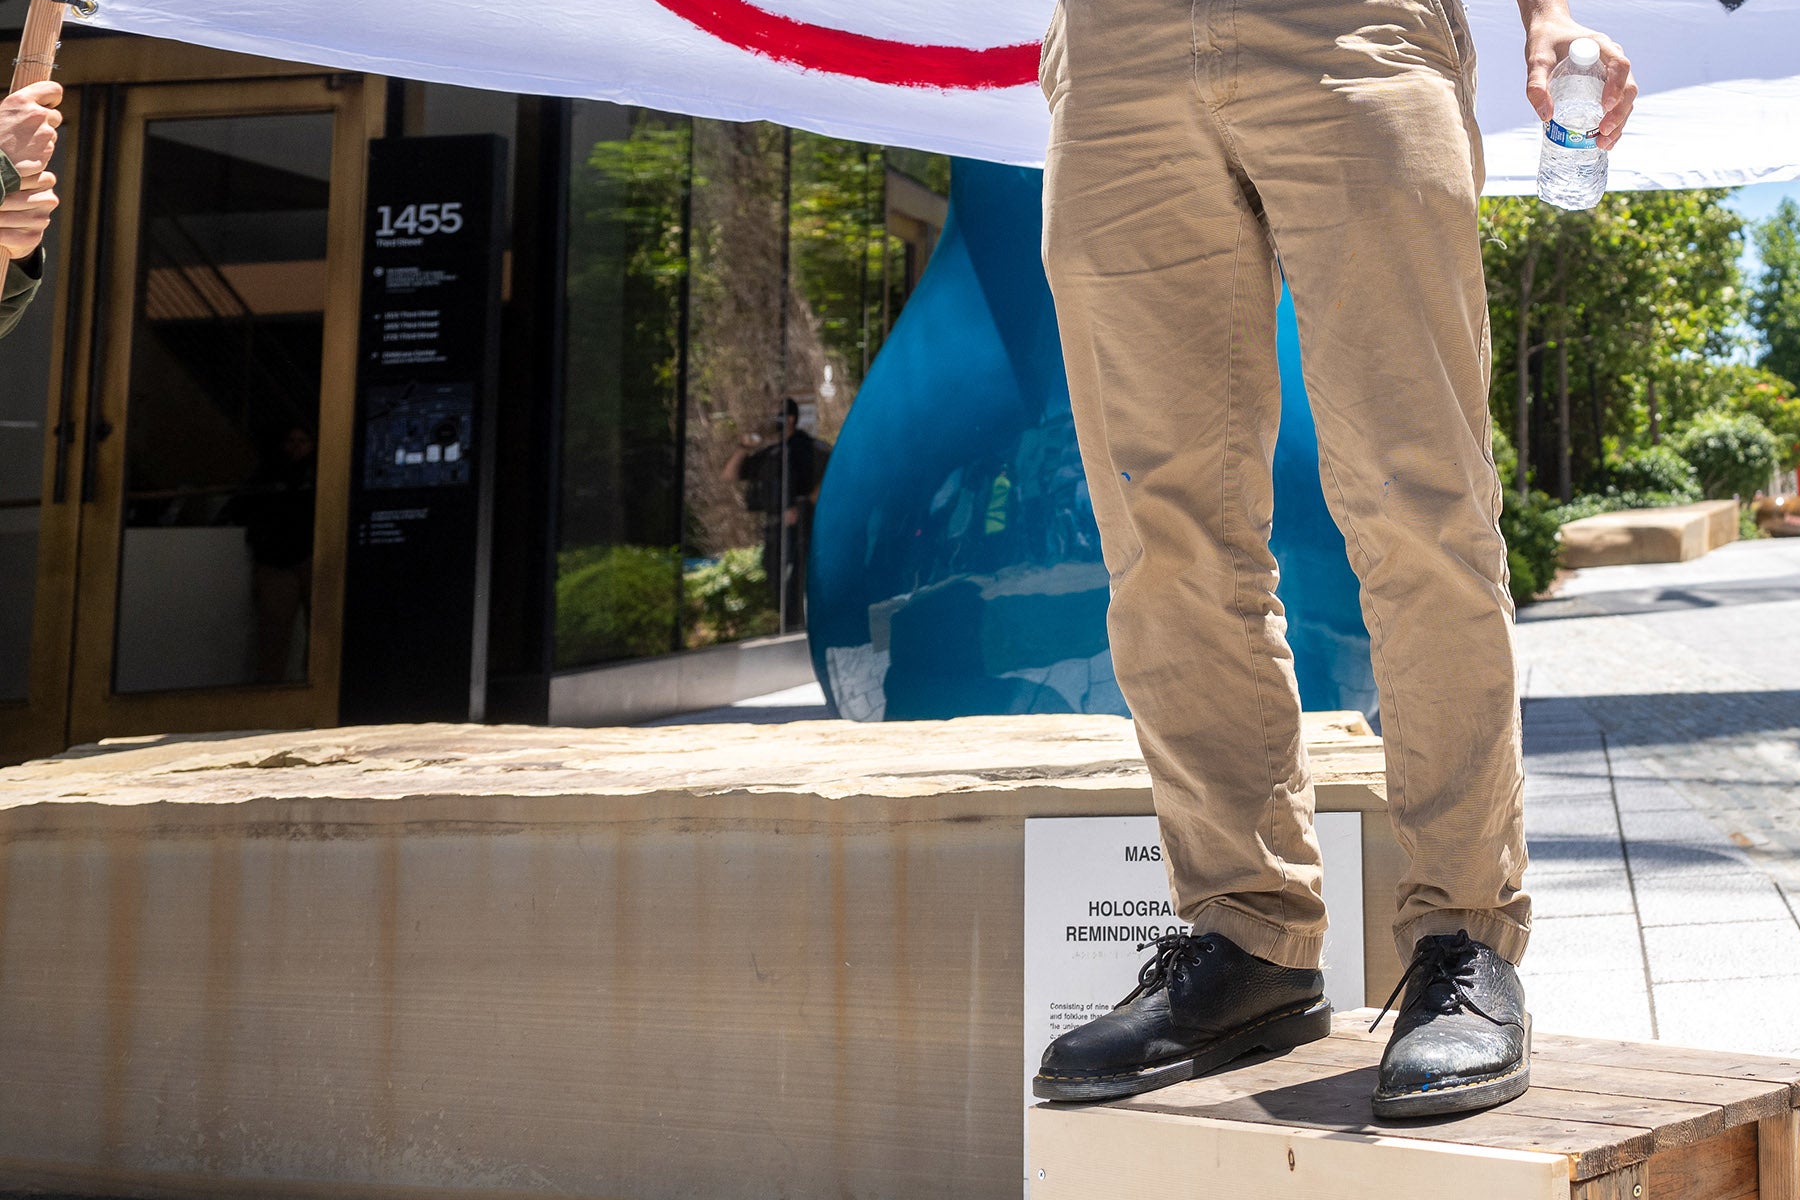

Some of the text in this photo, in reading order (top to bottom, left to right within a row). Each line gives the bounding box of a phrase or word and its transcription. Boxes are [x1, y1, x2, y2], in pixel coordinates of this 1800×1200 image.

[375, 202, 463, 237] 1455
[1125, 846, 1164, 862] MAS
[1088, 900, 1177, 917] HOLOGRA
[1066, 926, 1160, 942] REMINDING
[1050, 1002, 1085, 1011] Consisting
